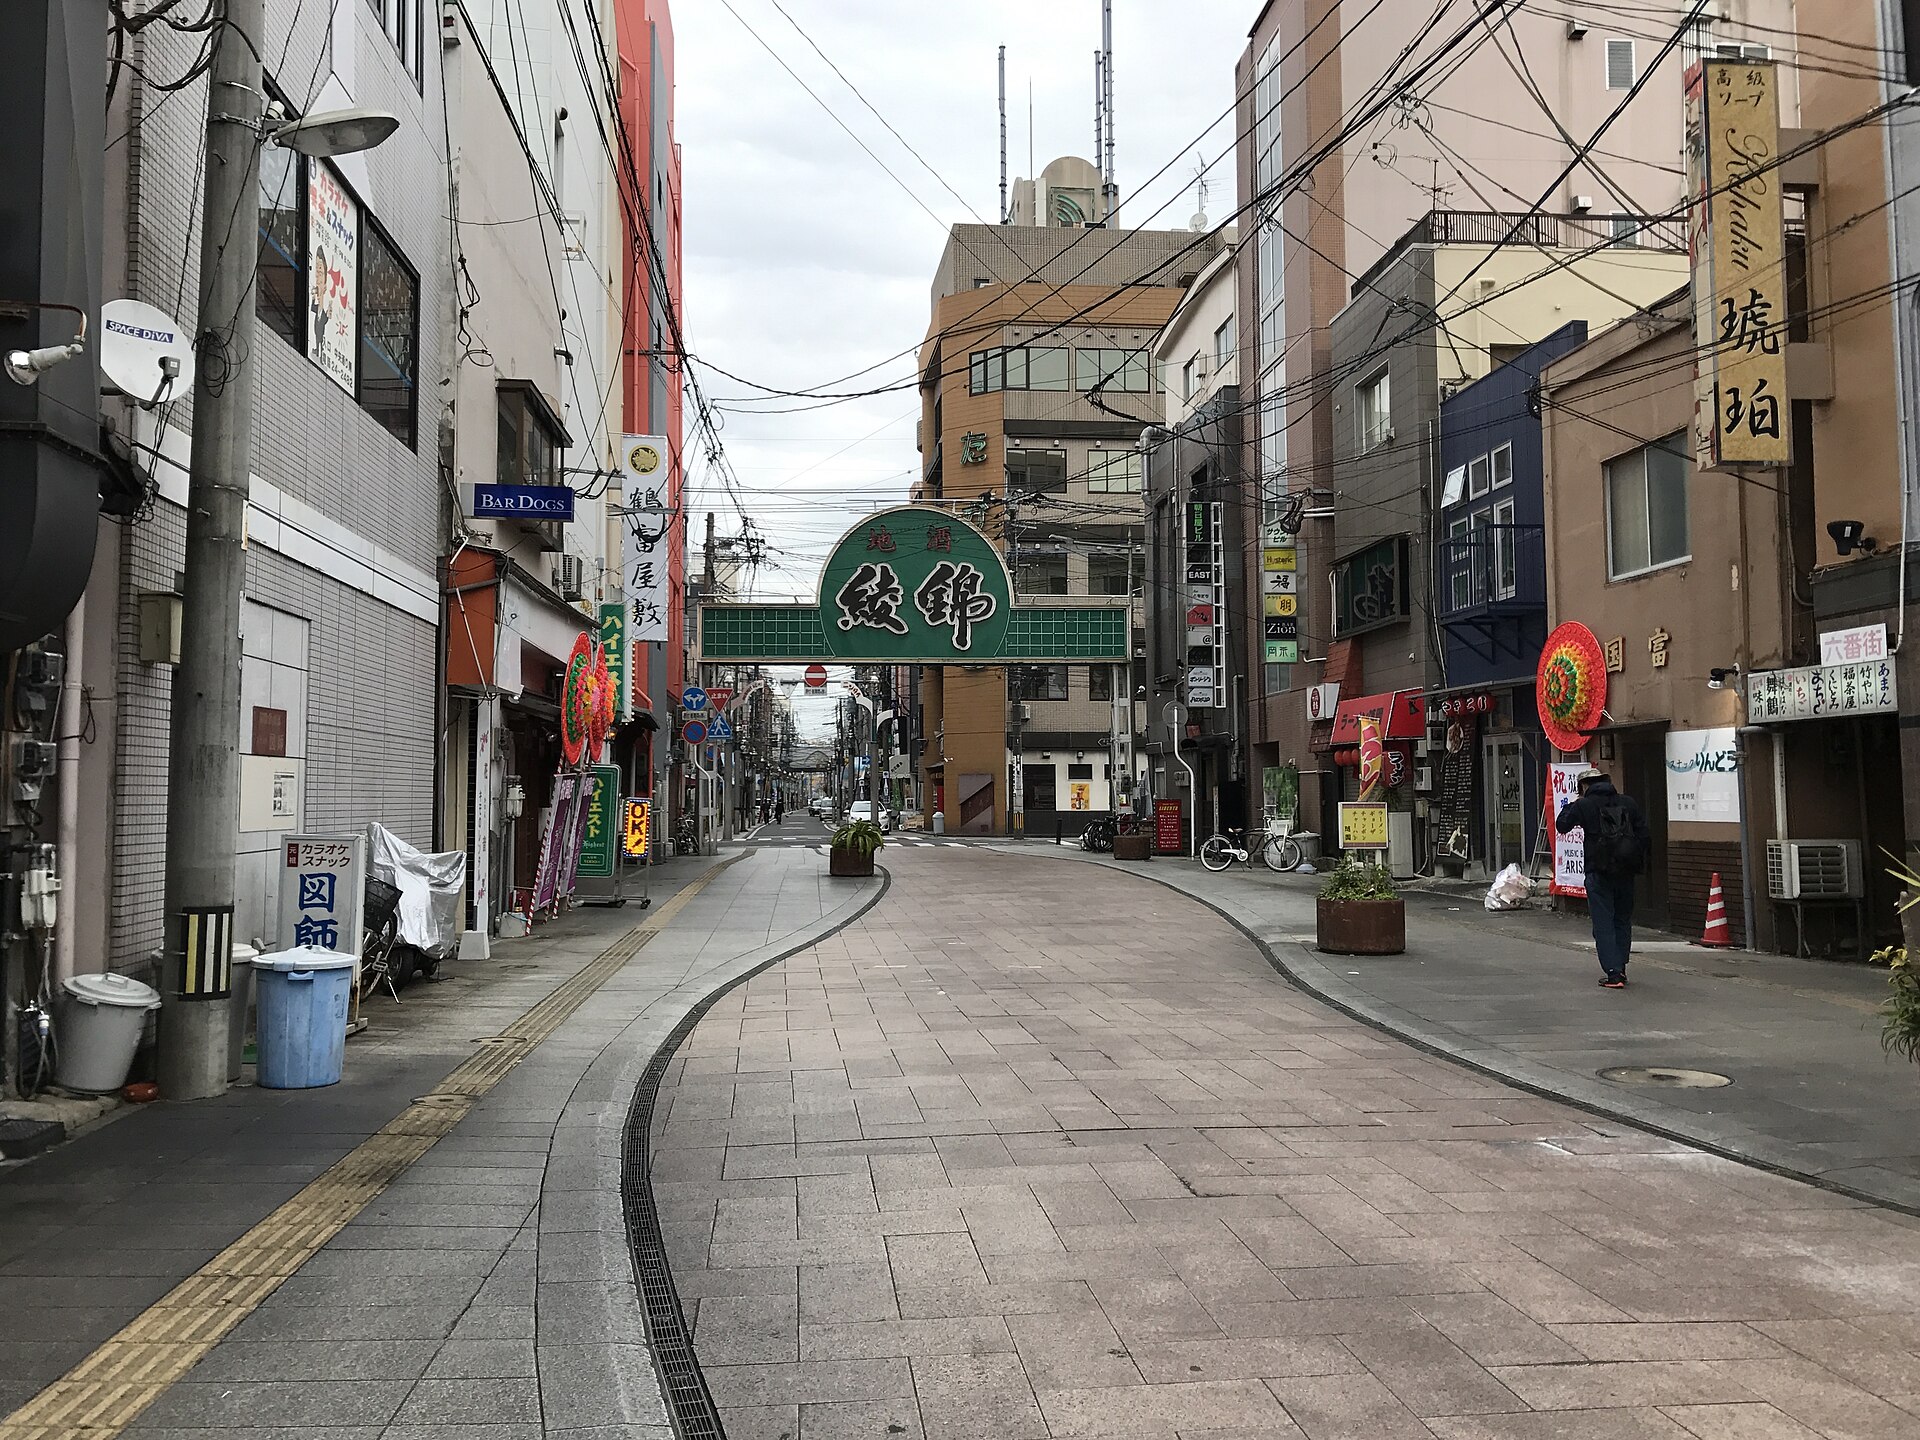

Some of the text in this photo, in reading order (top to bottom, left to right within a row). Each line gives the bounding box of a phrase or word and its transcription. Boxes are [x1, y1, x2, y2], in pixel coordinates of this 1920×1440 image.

[1716, 69, 1765, 87] 高級
[1718, 91, 1765, 107] ソープ
[319, 170, 349, 218] カラオケ
[1724, 127, 1769, 271] Kohaku
[108, 321, 140, 337] SPACE
[1719, 288, 1780, 440] 琥珀
[481, 494, 565, 511] BAR DOGS
[866, 524, 951, 553] 地酒
[628, 486, 662, 627] 鶴富屋敷
[1188, 571, 1211, 579] EAST
[1270, 574, 1290, 590] 福
[835, 560, 997, 651] 綾錦
[1266, 622, 1296, 634] Zion
[601, 614, 623, 690] ハイエス
[1824, 629, 1883, 662] 六番街
[1766, 676, 1778, 716] 舞鶴
[1795, 675, 1807, 713] いちご
[1842, 666, 1858, 710] 福茶屋
[1859, 665, 1874, 706] 竹やぶ
[1878, 662, 1892, 706] あまん
[1669, 750, 1738, 773] スナック りんどう
[1553, 769, 1568, 794] 祝
[301, 843, 349, 855] カラオケ
[302, 856, 351, 868] スナック
[293, 872, 339, 950] 図師
